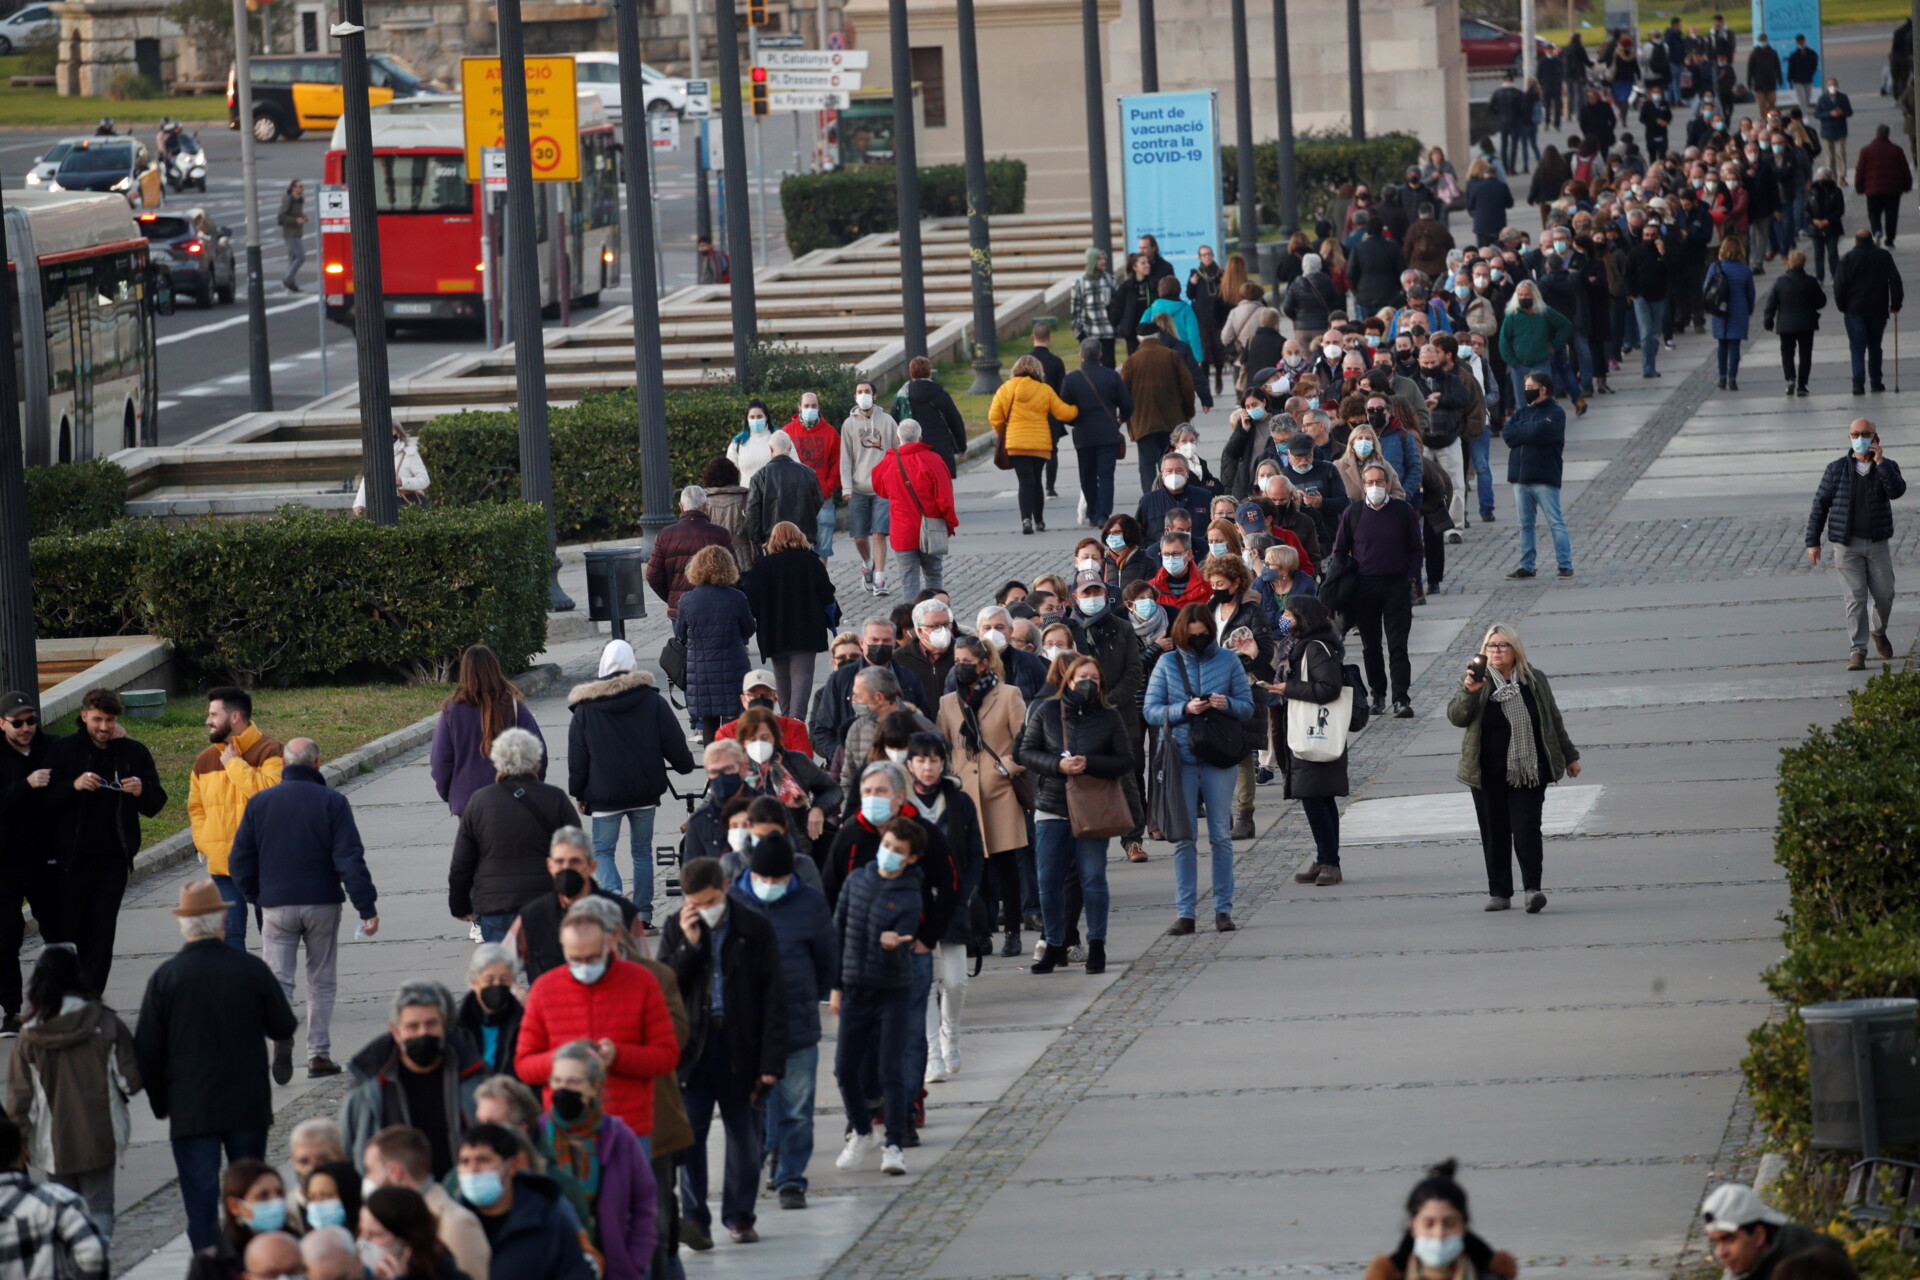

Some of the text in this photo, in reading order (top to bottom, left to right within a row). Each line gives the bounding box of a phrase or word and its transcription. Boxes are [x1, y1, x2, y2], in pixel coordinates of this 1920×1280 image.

[767, 54, 829, 66] Pl. Catalunya
[485, 63, 553, 80] ATCIÓ
[783, 75, 828, 85] Drassanes
[1131, 106, 1185, 121] Punt de
[1131, 120, 1204, 136] vacunació
[1132, 136, 1194, 150] contra la
[535, 148, 554, 159] 30
[1132, 149, 1203, 165] COVID-19
